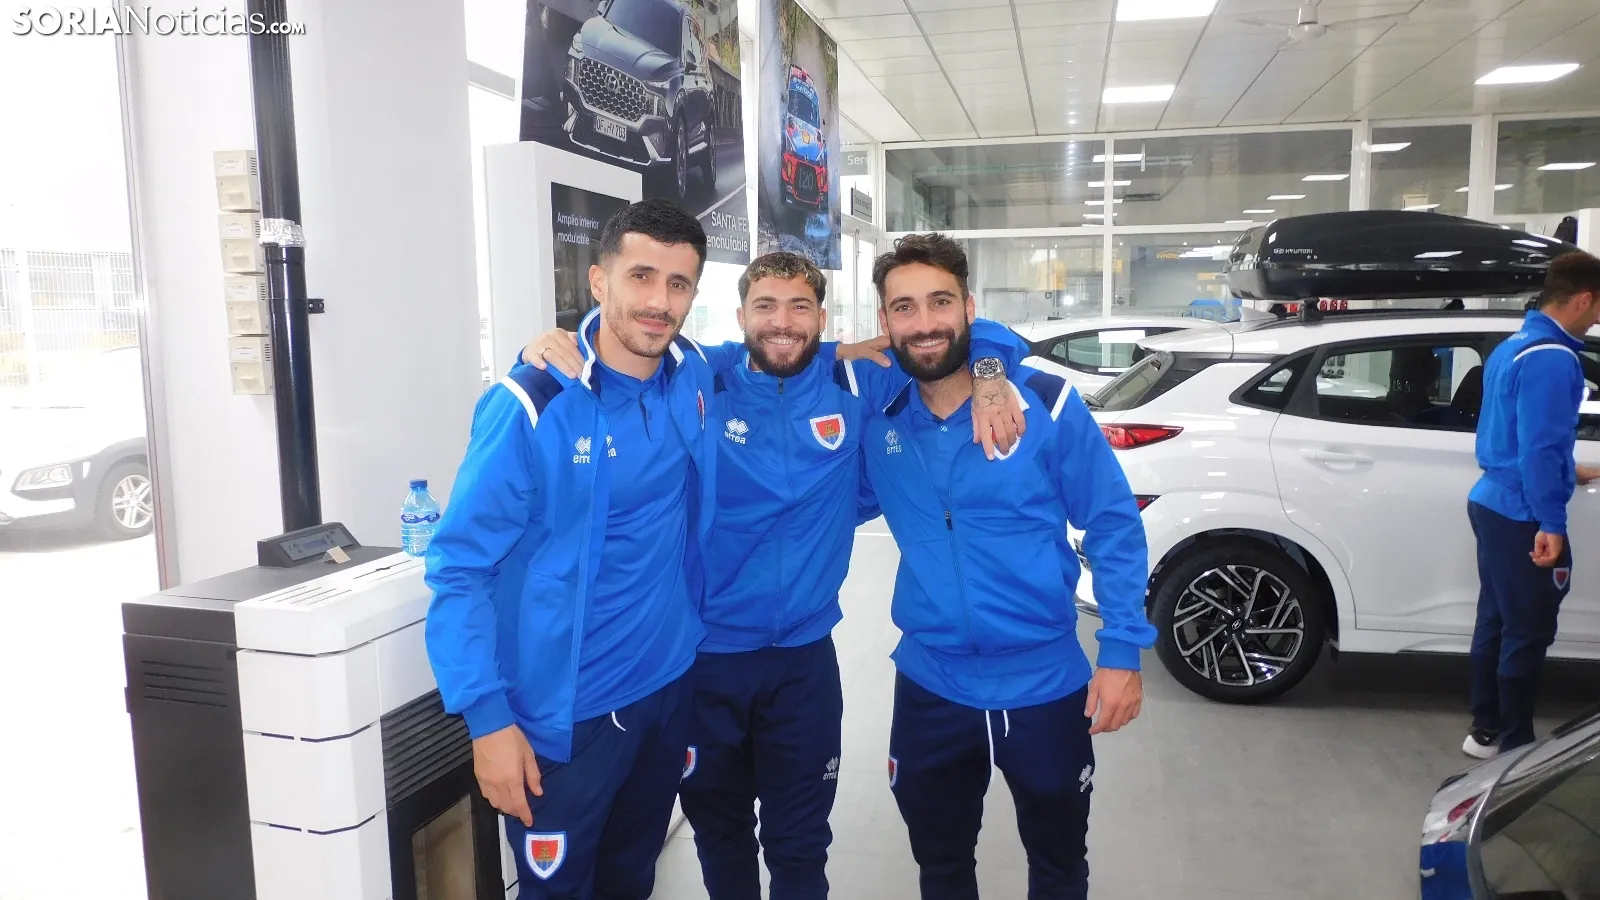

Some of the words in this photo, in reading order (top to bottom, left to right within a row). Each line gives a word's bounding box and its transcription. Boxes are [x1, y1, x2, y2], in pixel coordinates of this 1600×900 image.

[711, 210, 737, 230] SANTA
[738, 217, 747, 231] FE
[706, 234, 747, 252] enchufable
